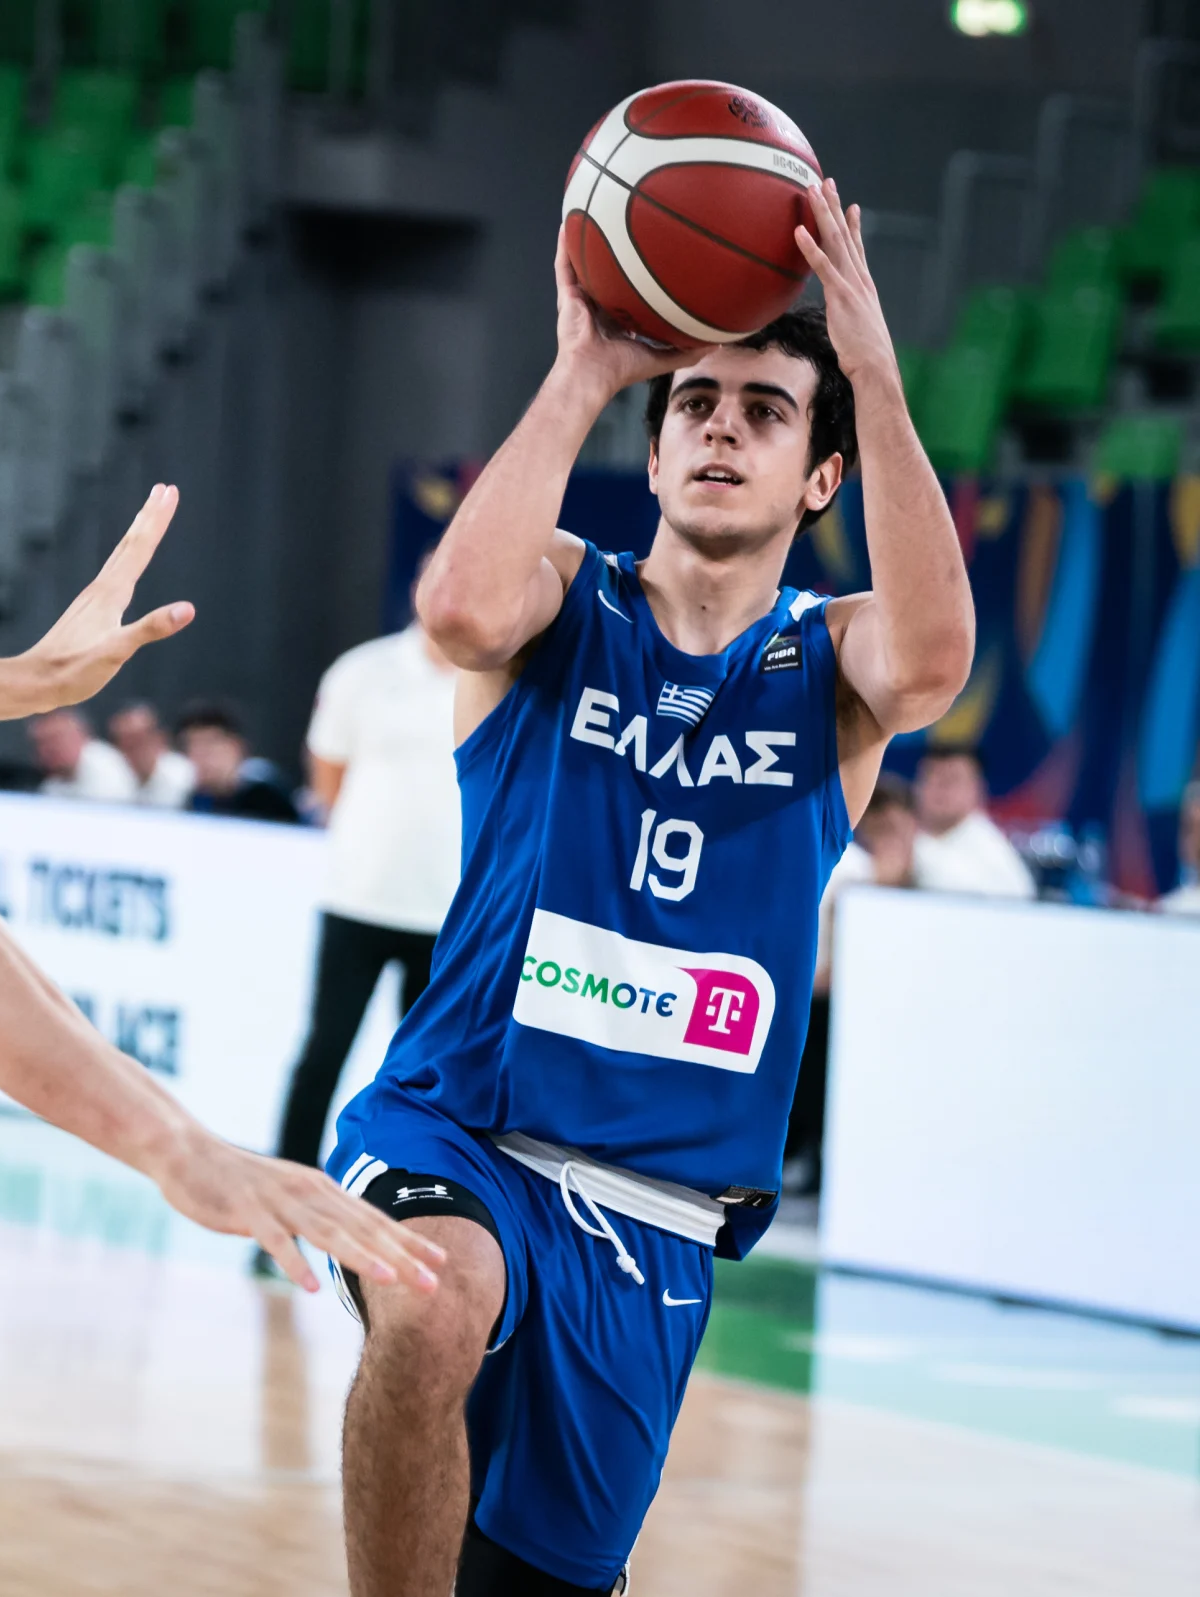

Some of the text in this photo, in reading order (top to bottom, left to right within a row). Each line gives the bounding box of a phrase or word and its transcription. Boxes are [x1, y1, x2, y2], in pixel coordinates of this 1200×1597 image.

[767, 646, 796, 661] FIBA
[569, 686, 797, 787] ΕΛΛΑΣ
[629, 808, 704, 902] 19
[520, 955, 678, 1018] COSMOTE
